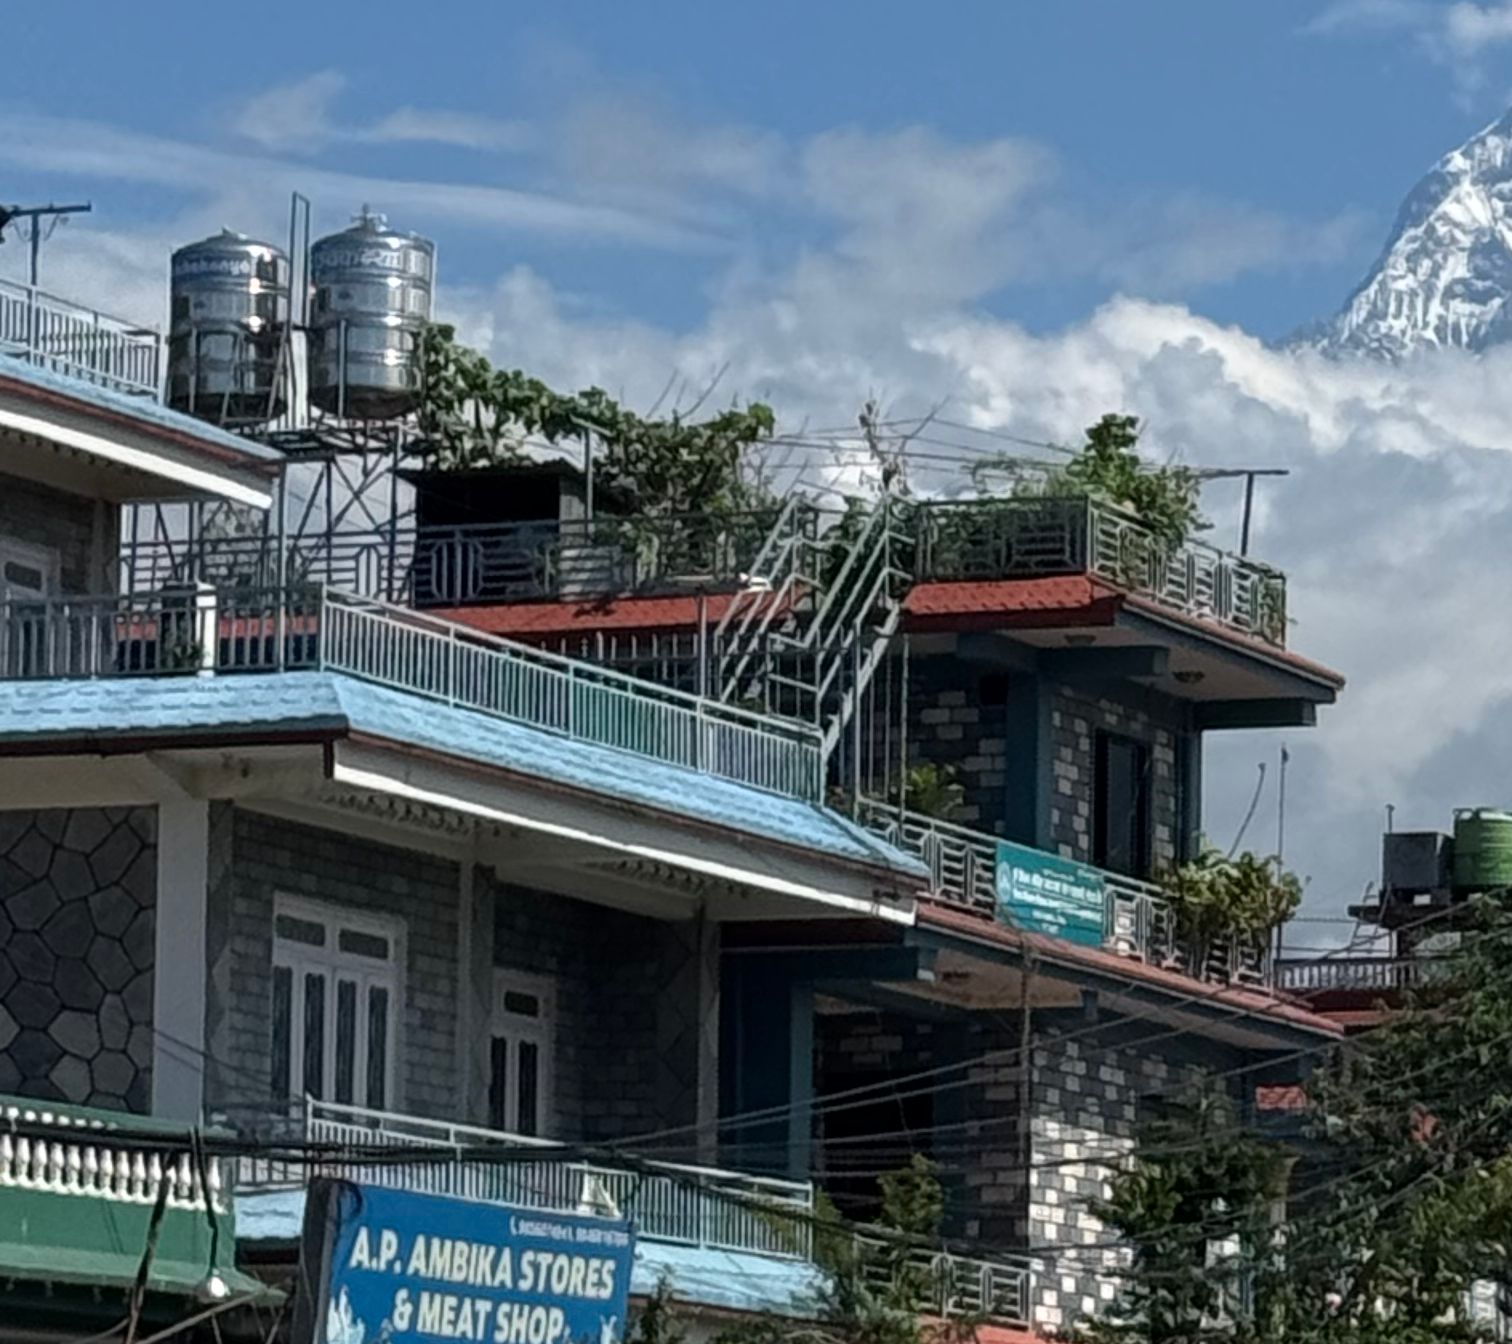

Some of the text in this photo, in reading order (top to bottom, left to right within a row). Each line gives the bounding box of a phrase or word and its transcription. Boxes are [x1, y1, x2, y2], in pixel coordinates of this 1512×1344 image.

[351, 1226, 616, 1300] A.P. AMBIKA STORES
[392, 1288, 413, 1333] &
[416, 1291, 492, 1341] MEAT
